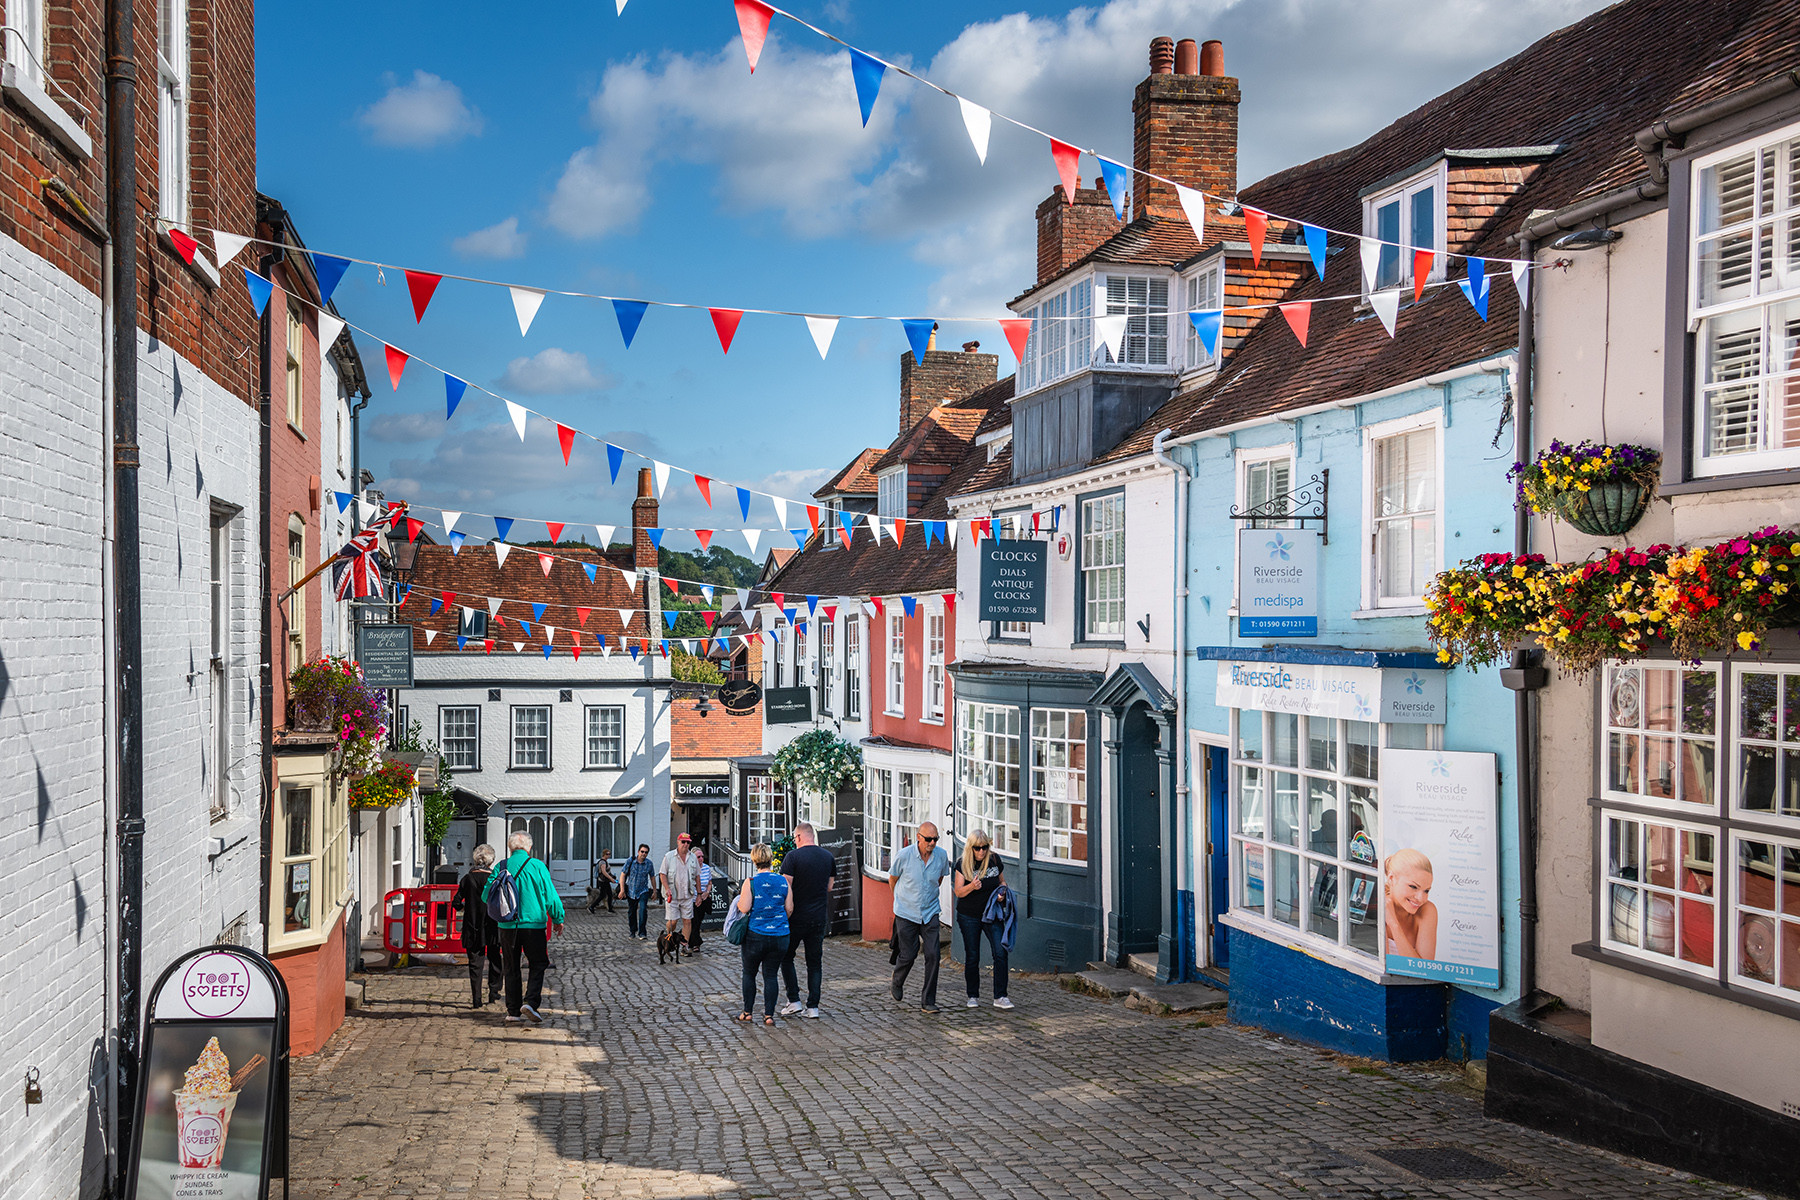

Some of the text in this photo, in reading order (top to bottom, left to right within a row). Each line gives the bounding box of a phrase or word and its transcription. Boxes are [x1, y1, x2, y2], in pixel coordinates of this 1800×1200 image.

[991, 551, 1037, 562] CLOCKS
[1000, 568, 1027, 576] DIALS
[1253, 566, 1303, 577] Riverside
[991, 580, 1034, 590] ANTIQUE
[994, 591, 1031, 600] CLOCKS
[1254, 594, 1304, 609] medispa
[988, 605, 1037, 614] 01590 673258
[1251, 620, 1306, 628] T: 01590 671211
[366, 630, 406, 641] Bridgeford
[1231, 664, 1292, 690] Riverside
[1295, 678, 1318, 691] BEAU
[1260, 689, 1277, 708] Relax
[1392, 701, 1436, 712] Riverside
[678, 783, 730, 794] bike hire
[1416, 781, 1468, 795] Riverside
[1450, 825, 1474, 843] Relax
[1450, 873, 1480, 886] Restore
[1450, 918, 1478, 931] Revive
[1407, 959, 1474, 976] T: 01590 671211
[197, 972, 240, 984] TOOT
[206, 1172, 229, 1180] CREAM
